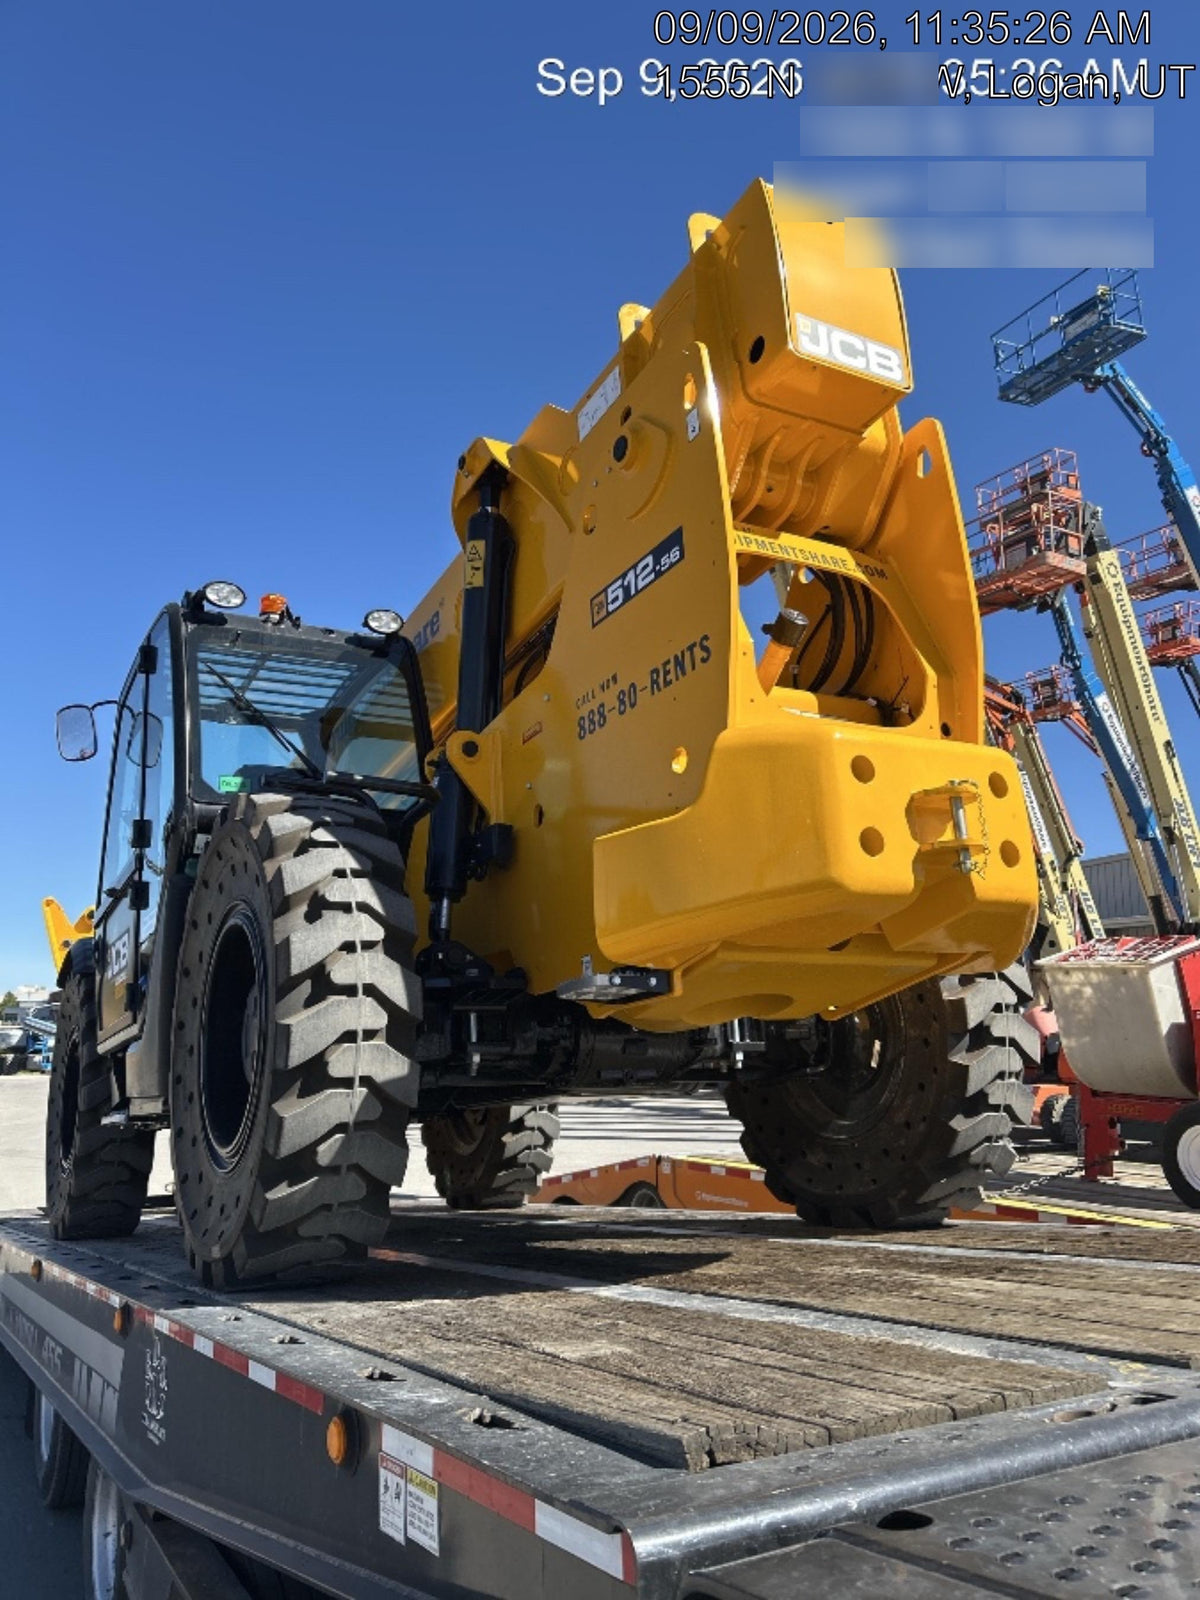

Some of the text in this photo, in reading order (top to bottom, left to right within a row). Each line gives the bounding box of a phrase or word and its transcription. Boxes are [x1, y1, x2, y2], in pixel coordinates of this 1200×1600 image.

[800, 321, 903, 381] JCB
[733, 534, 889, 580] IPMENTSHARE.COM
[577, 634, 712, 740] 888-80-RENTS
